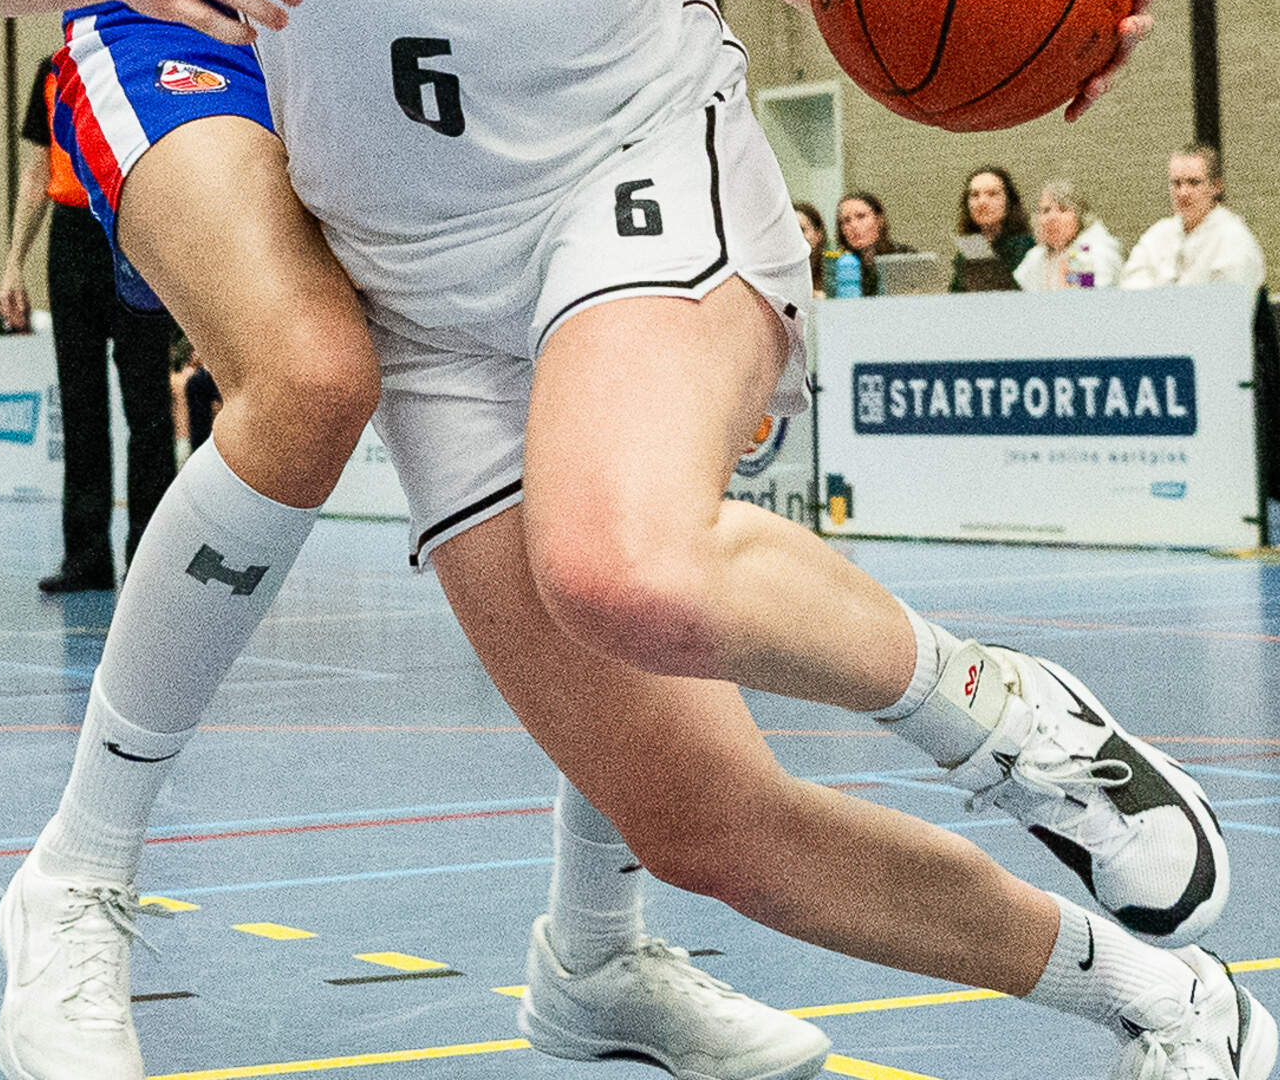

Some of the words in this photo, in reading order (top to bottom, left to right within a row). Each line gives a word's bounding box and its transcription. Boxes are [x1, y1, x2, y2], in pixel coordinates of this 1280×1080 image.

[390, 36, 466, 138] 6
[614, 177, 664, 238] 6
[888, 375, 1188, 419] STARTPORTAAL
